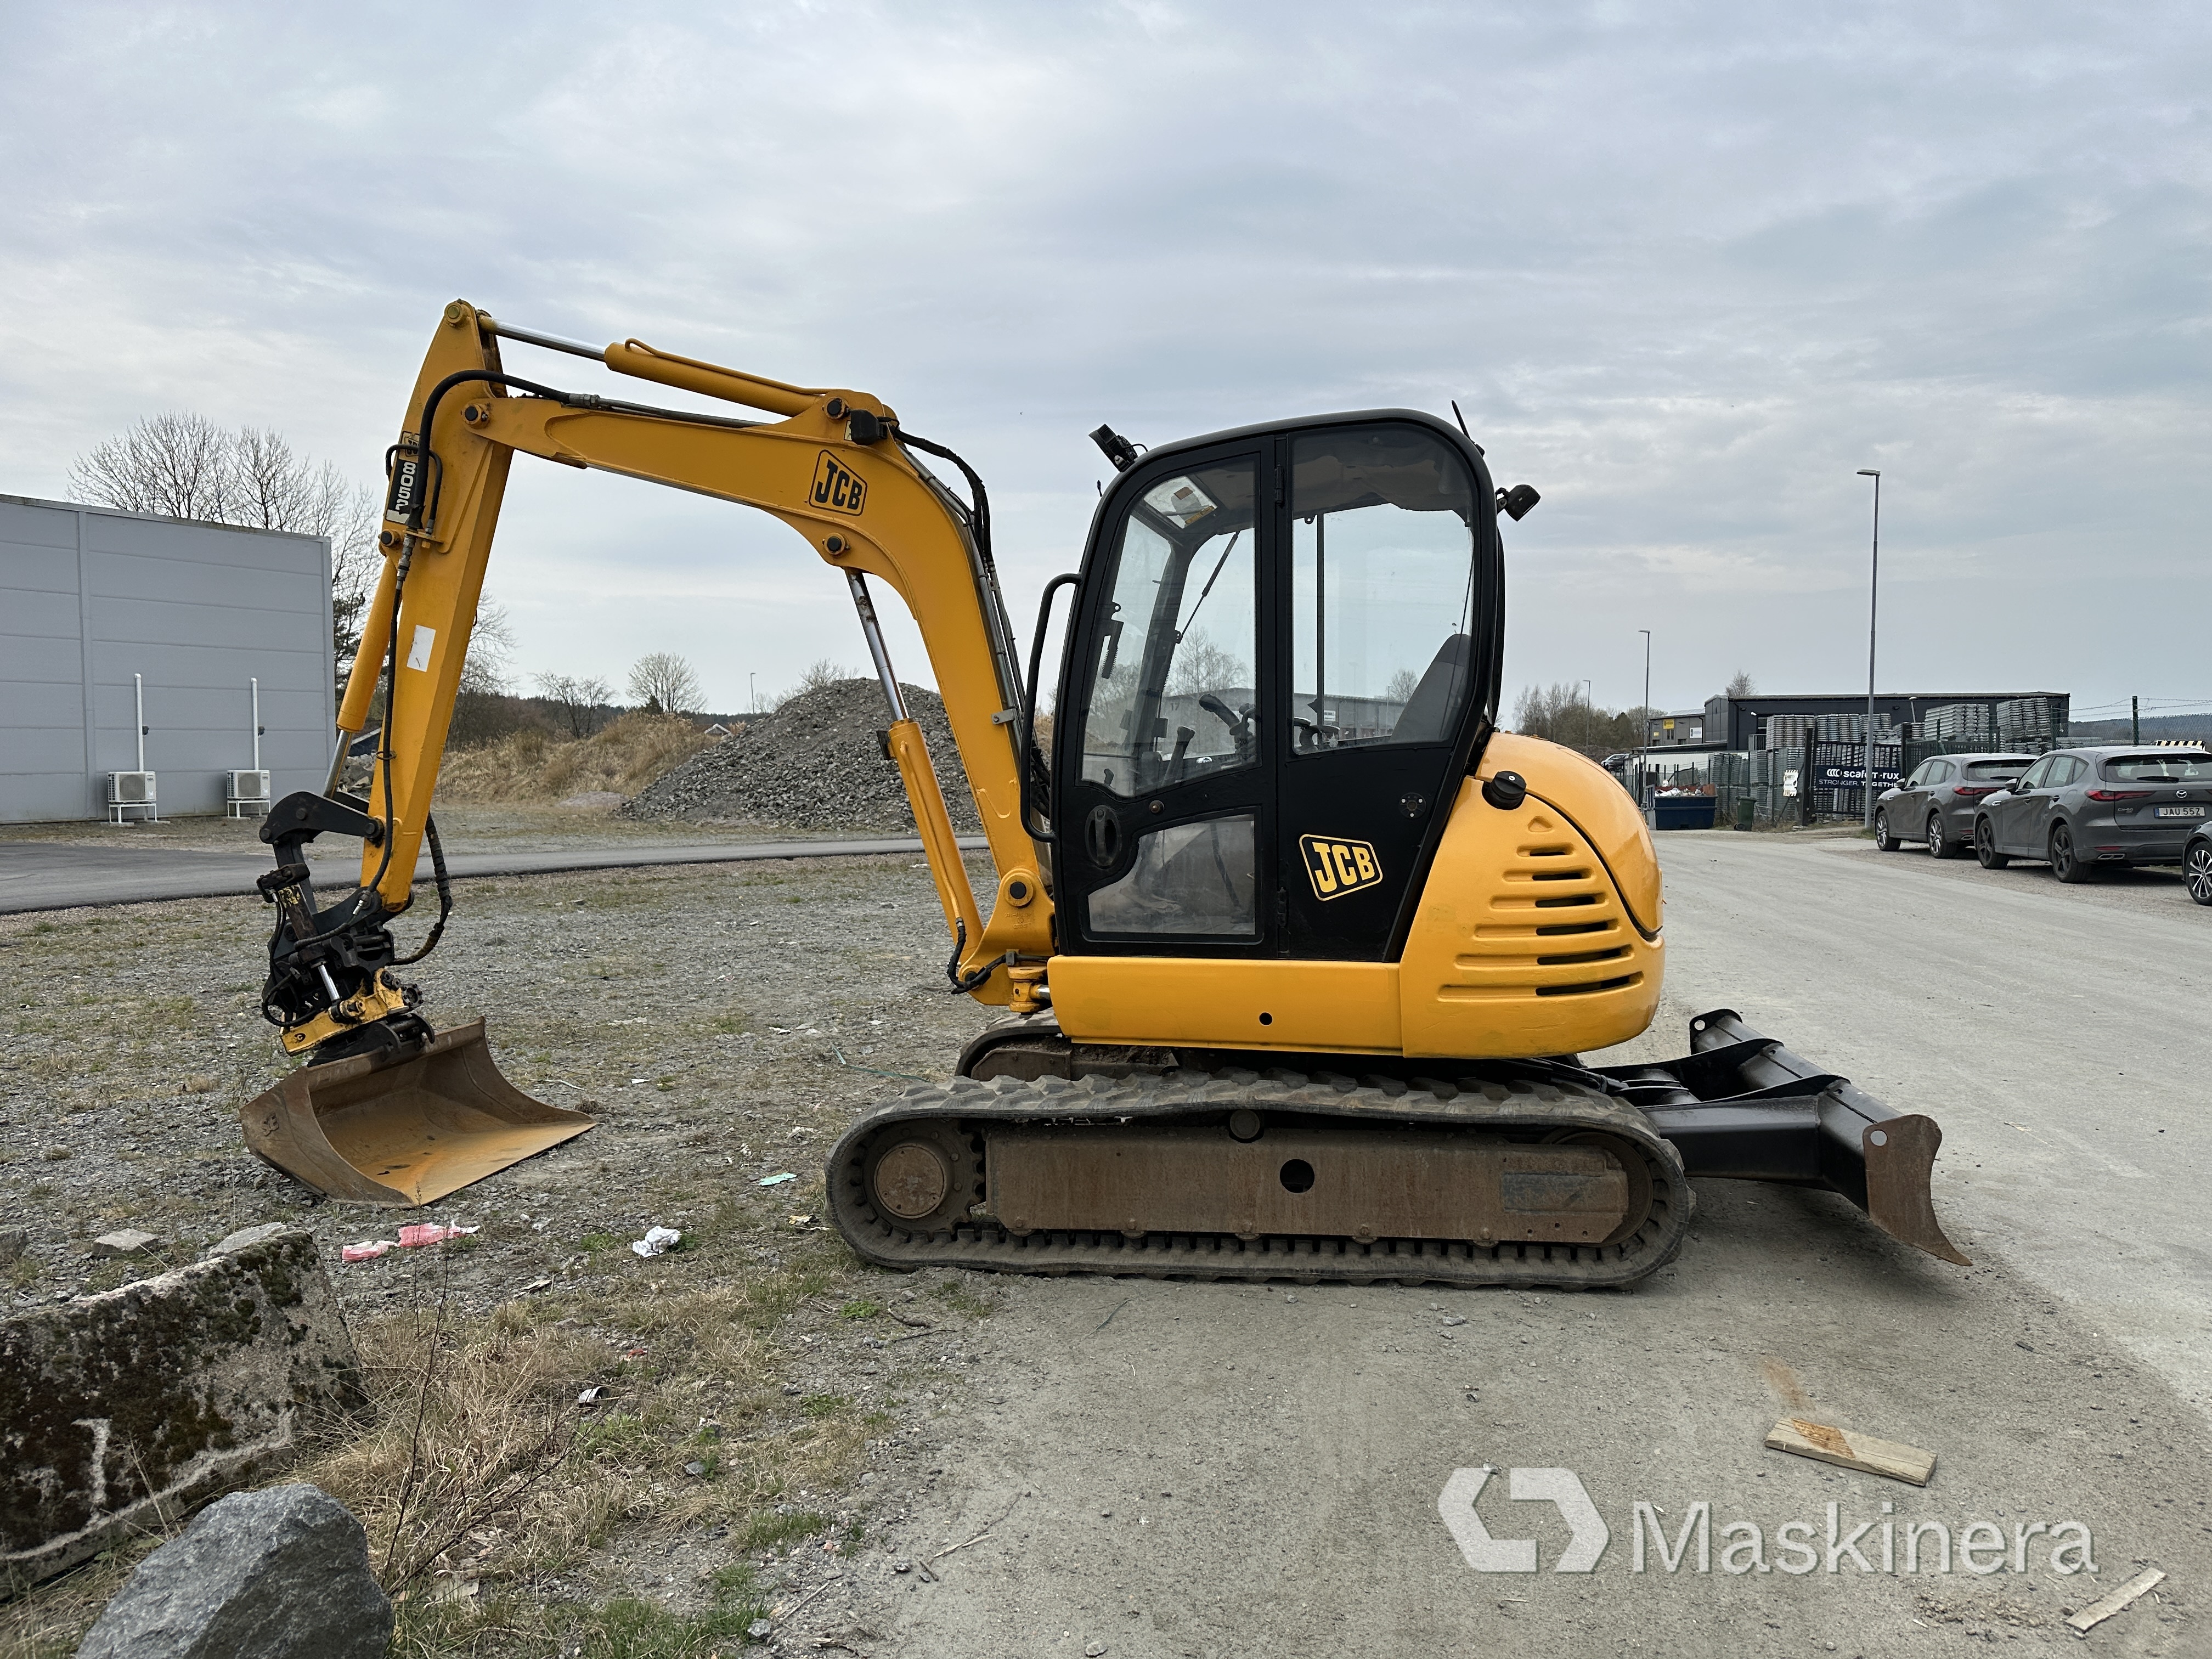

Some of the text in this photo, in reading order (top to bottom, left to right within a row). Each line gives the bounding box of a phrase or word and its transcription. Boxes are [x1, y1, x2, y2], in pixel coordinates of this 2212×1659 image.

[395, 461, 416, 511] 8052
[815, 459, 862, 510] JCB
[1170, 703, 1180, 711] 17
[1843, 770, 1899, 780] scafm-rux
[1312, 842, 1375, 893] JCB
